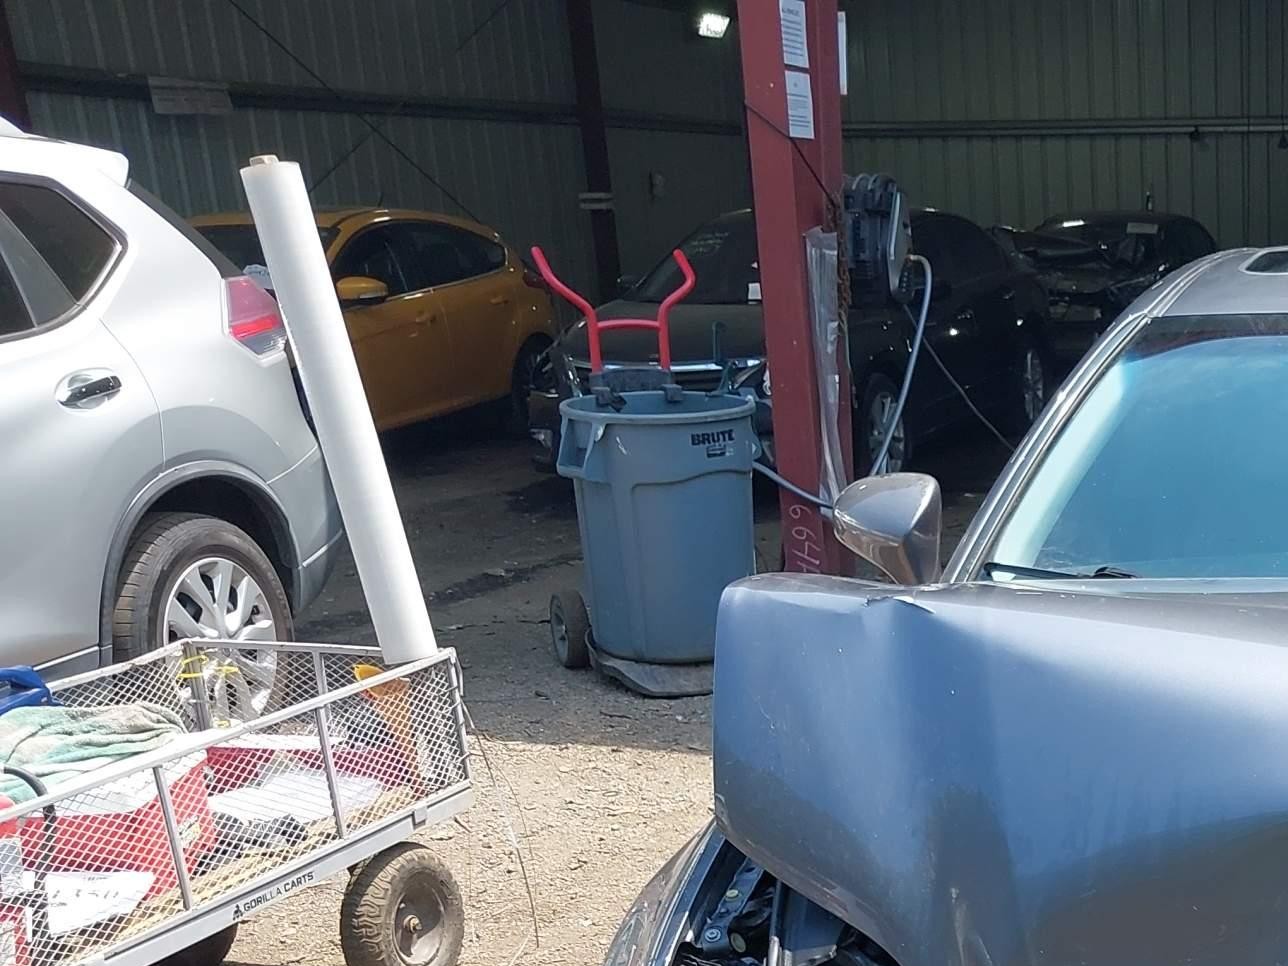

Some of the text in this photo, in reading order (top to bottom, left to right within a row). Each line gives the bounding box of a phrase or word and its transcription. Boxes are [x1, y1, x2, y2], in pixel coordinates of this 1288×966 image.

[690, 428, 735, 446] BRUTE
[243, 871, 314, 912] GORILLA CARTS
